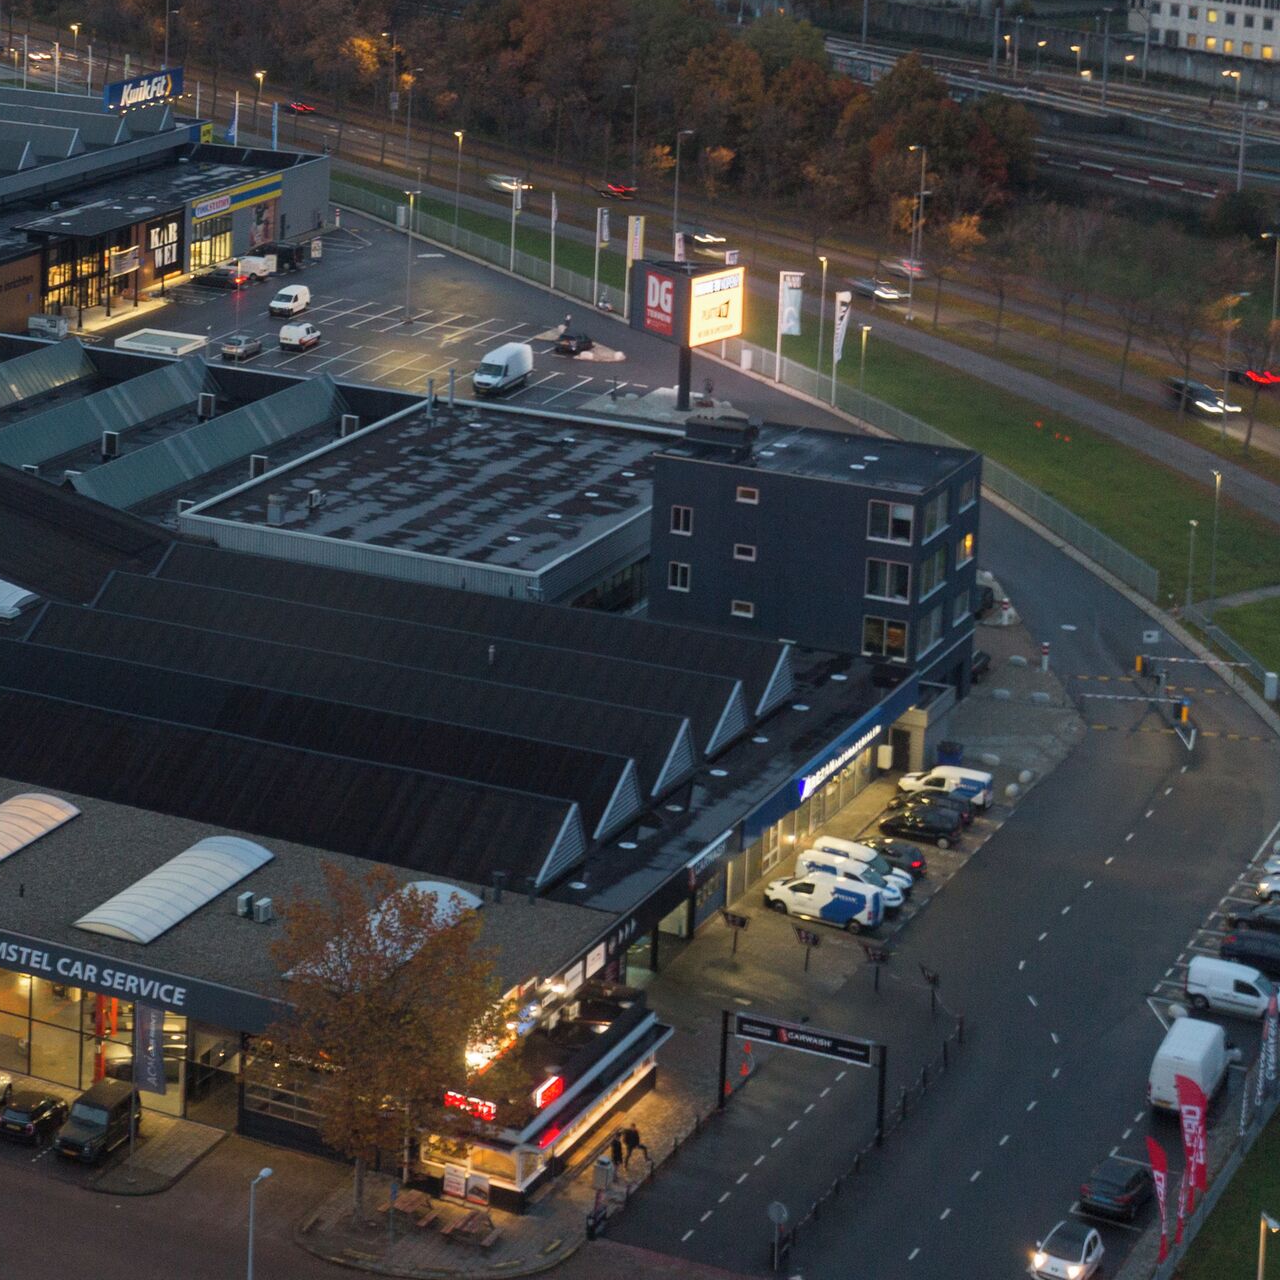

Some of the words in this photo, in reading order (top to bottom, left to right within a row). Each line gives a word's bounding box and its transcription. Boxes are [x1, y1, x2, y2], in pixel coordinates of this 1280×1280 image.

[120, 74, 167, 107] KwikFit
[149, 222, 179, 250] KAR
[154, 242, 178, 269] WEI
[647, 274, 673, 314] DG
[56, 956, 98, 984] CAR
[99, 968, 187, 1007] SERVICE
